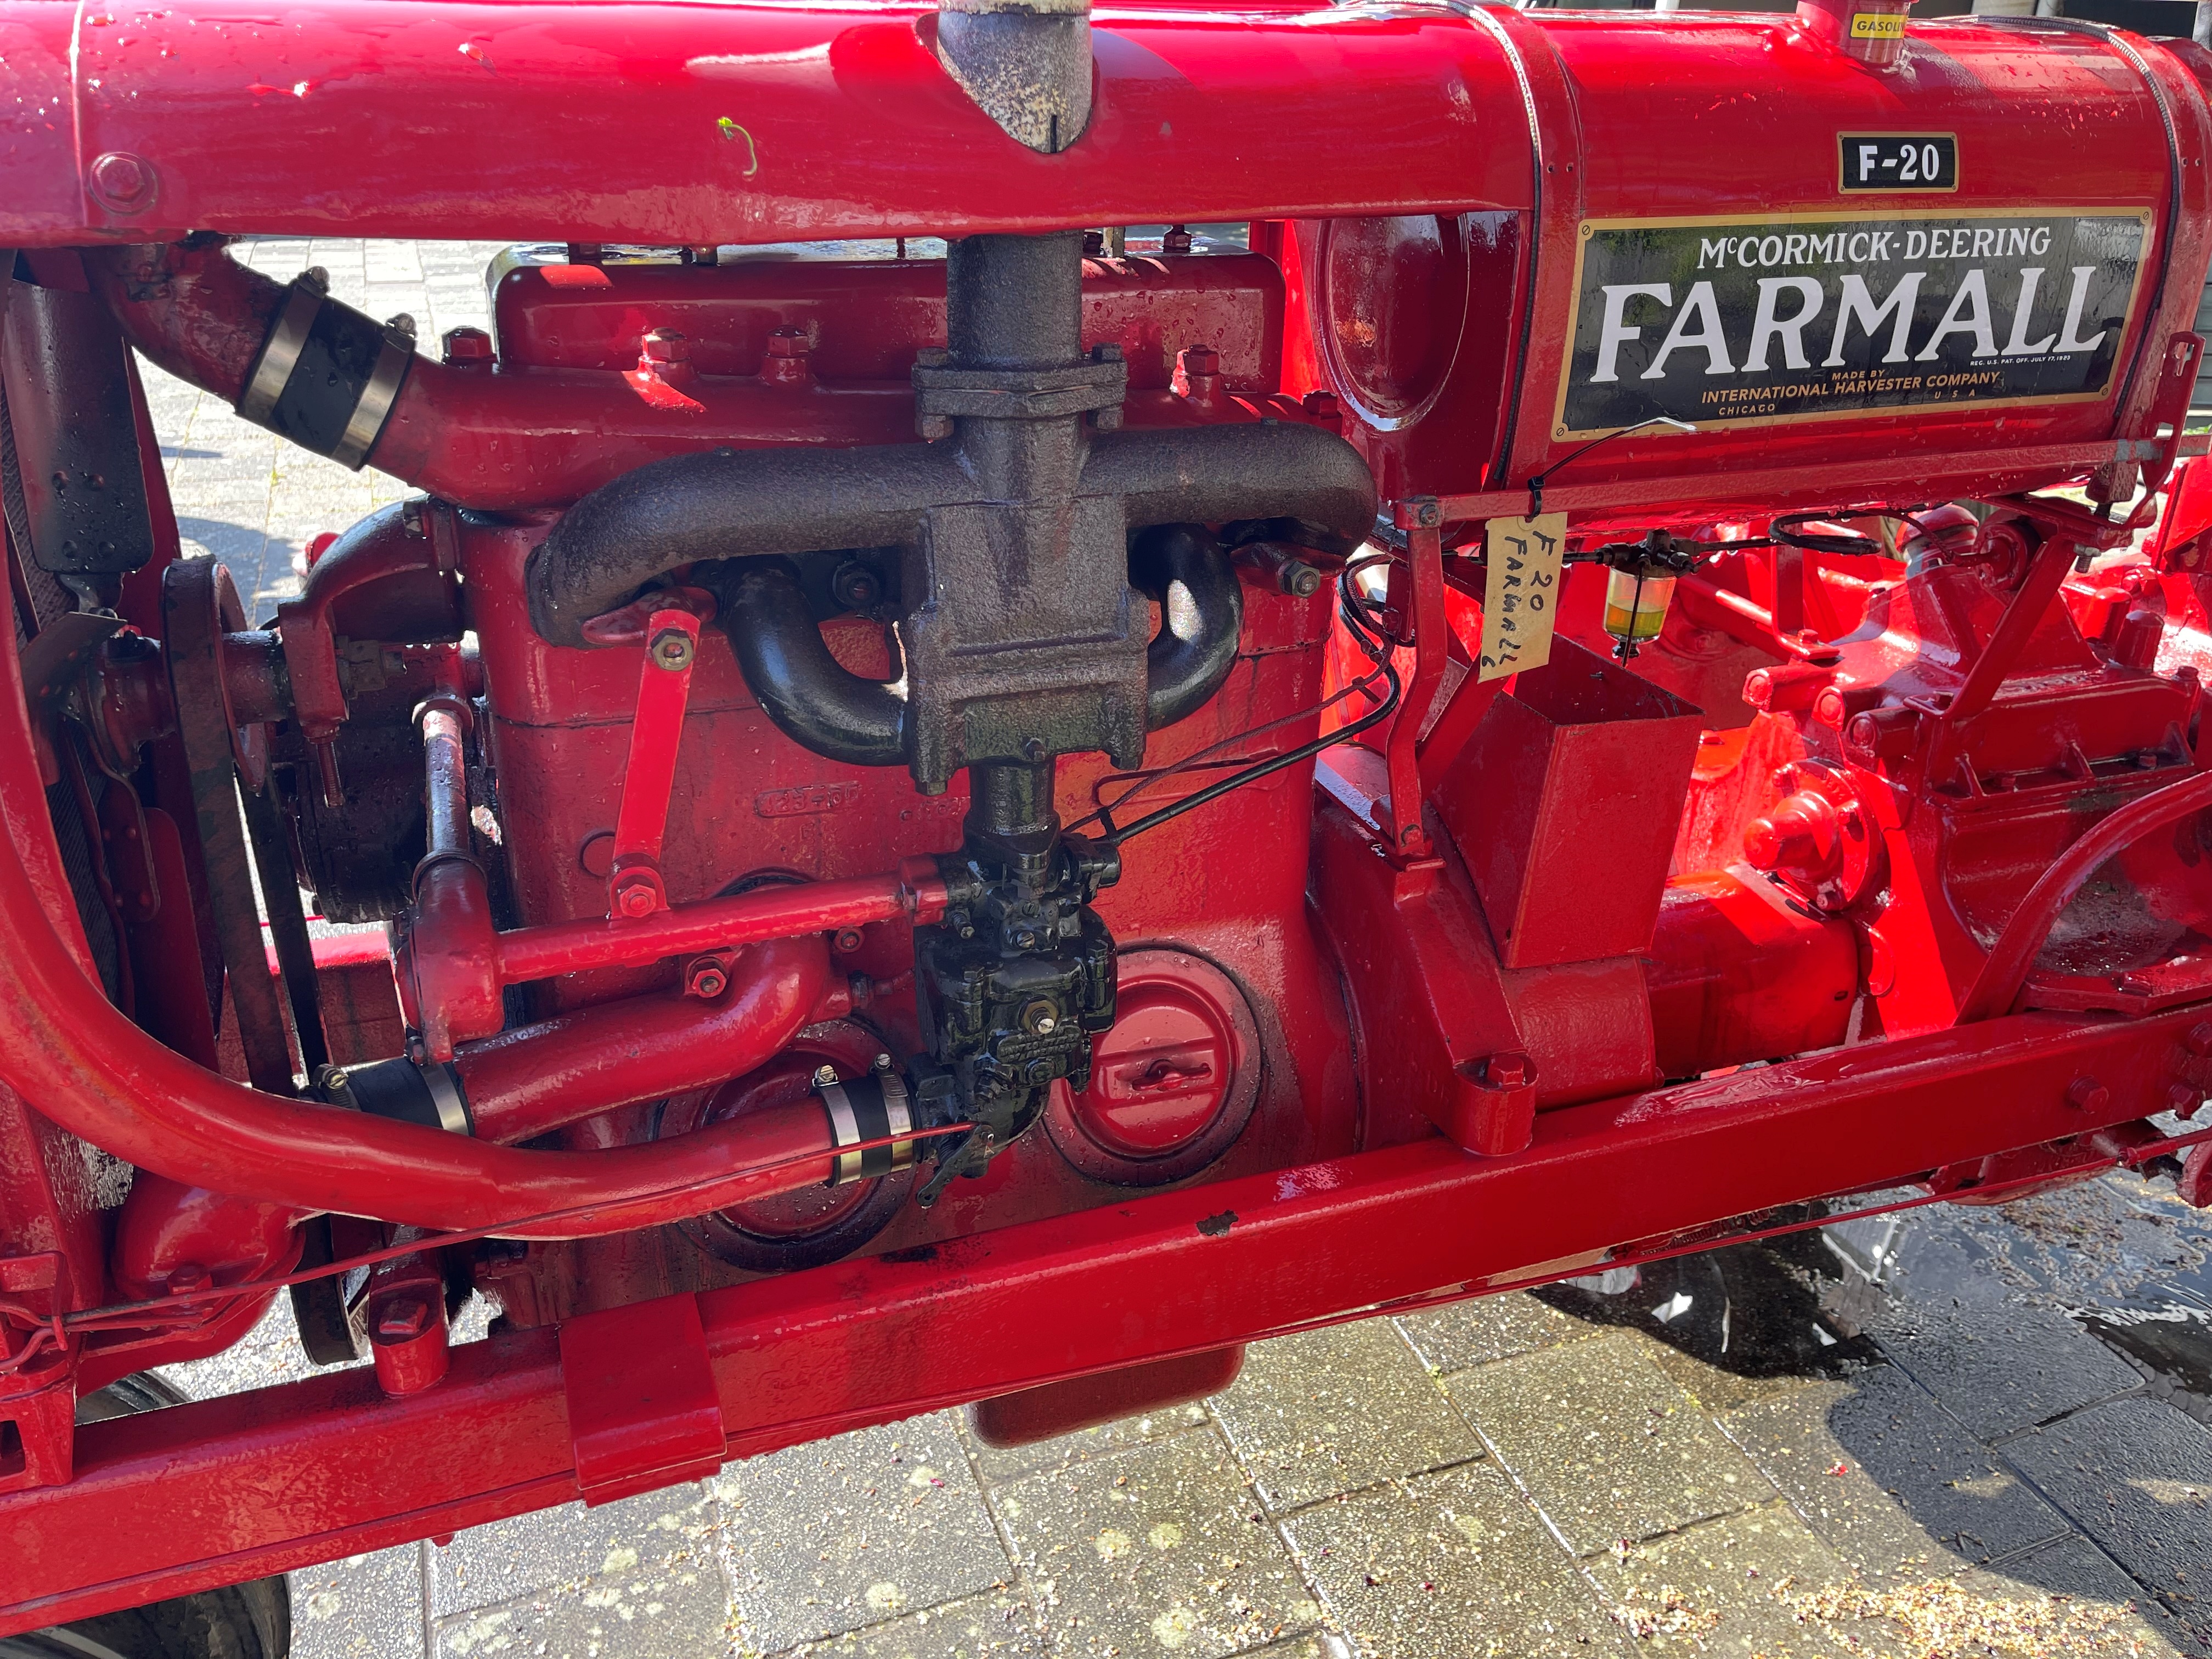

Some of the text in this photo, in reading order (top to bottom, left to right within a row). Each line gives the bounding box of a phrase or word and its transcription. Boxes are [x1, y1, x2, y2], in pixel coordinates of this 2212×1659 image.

[1859, 144, 1939, 181] F-20
[1589, 266, 2106, 382] FARMALL
[1702, 371, 2001, 403] INTERNATIONAL HARVESTER COMPANY
[1832, 369, 1885, 381] MADE BY
[1718, 403, 1775, 415] CHICAGO
[1530, 531, 1557, 611] F 20
[1498, 536, 1527, 665] FARMALL
